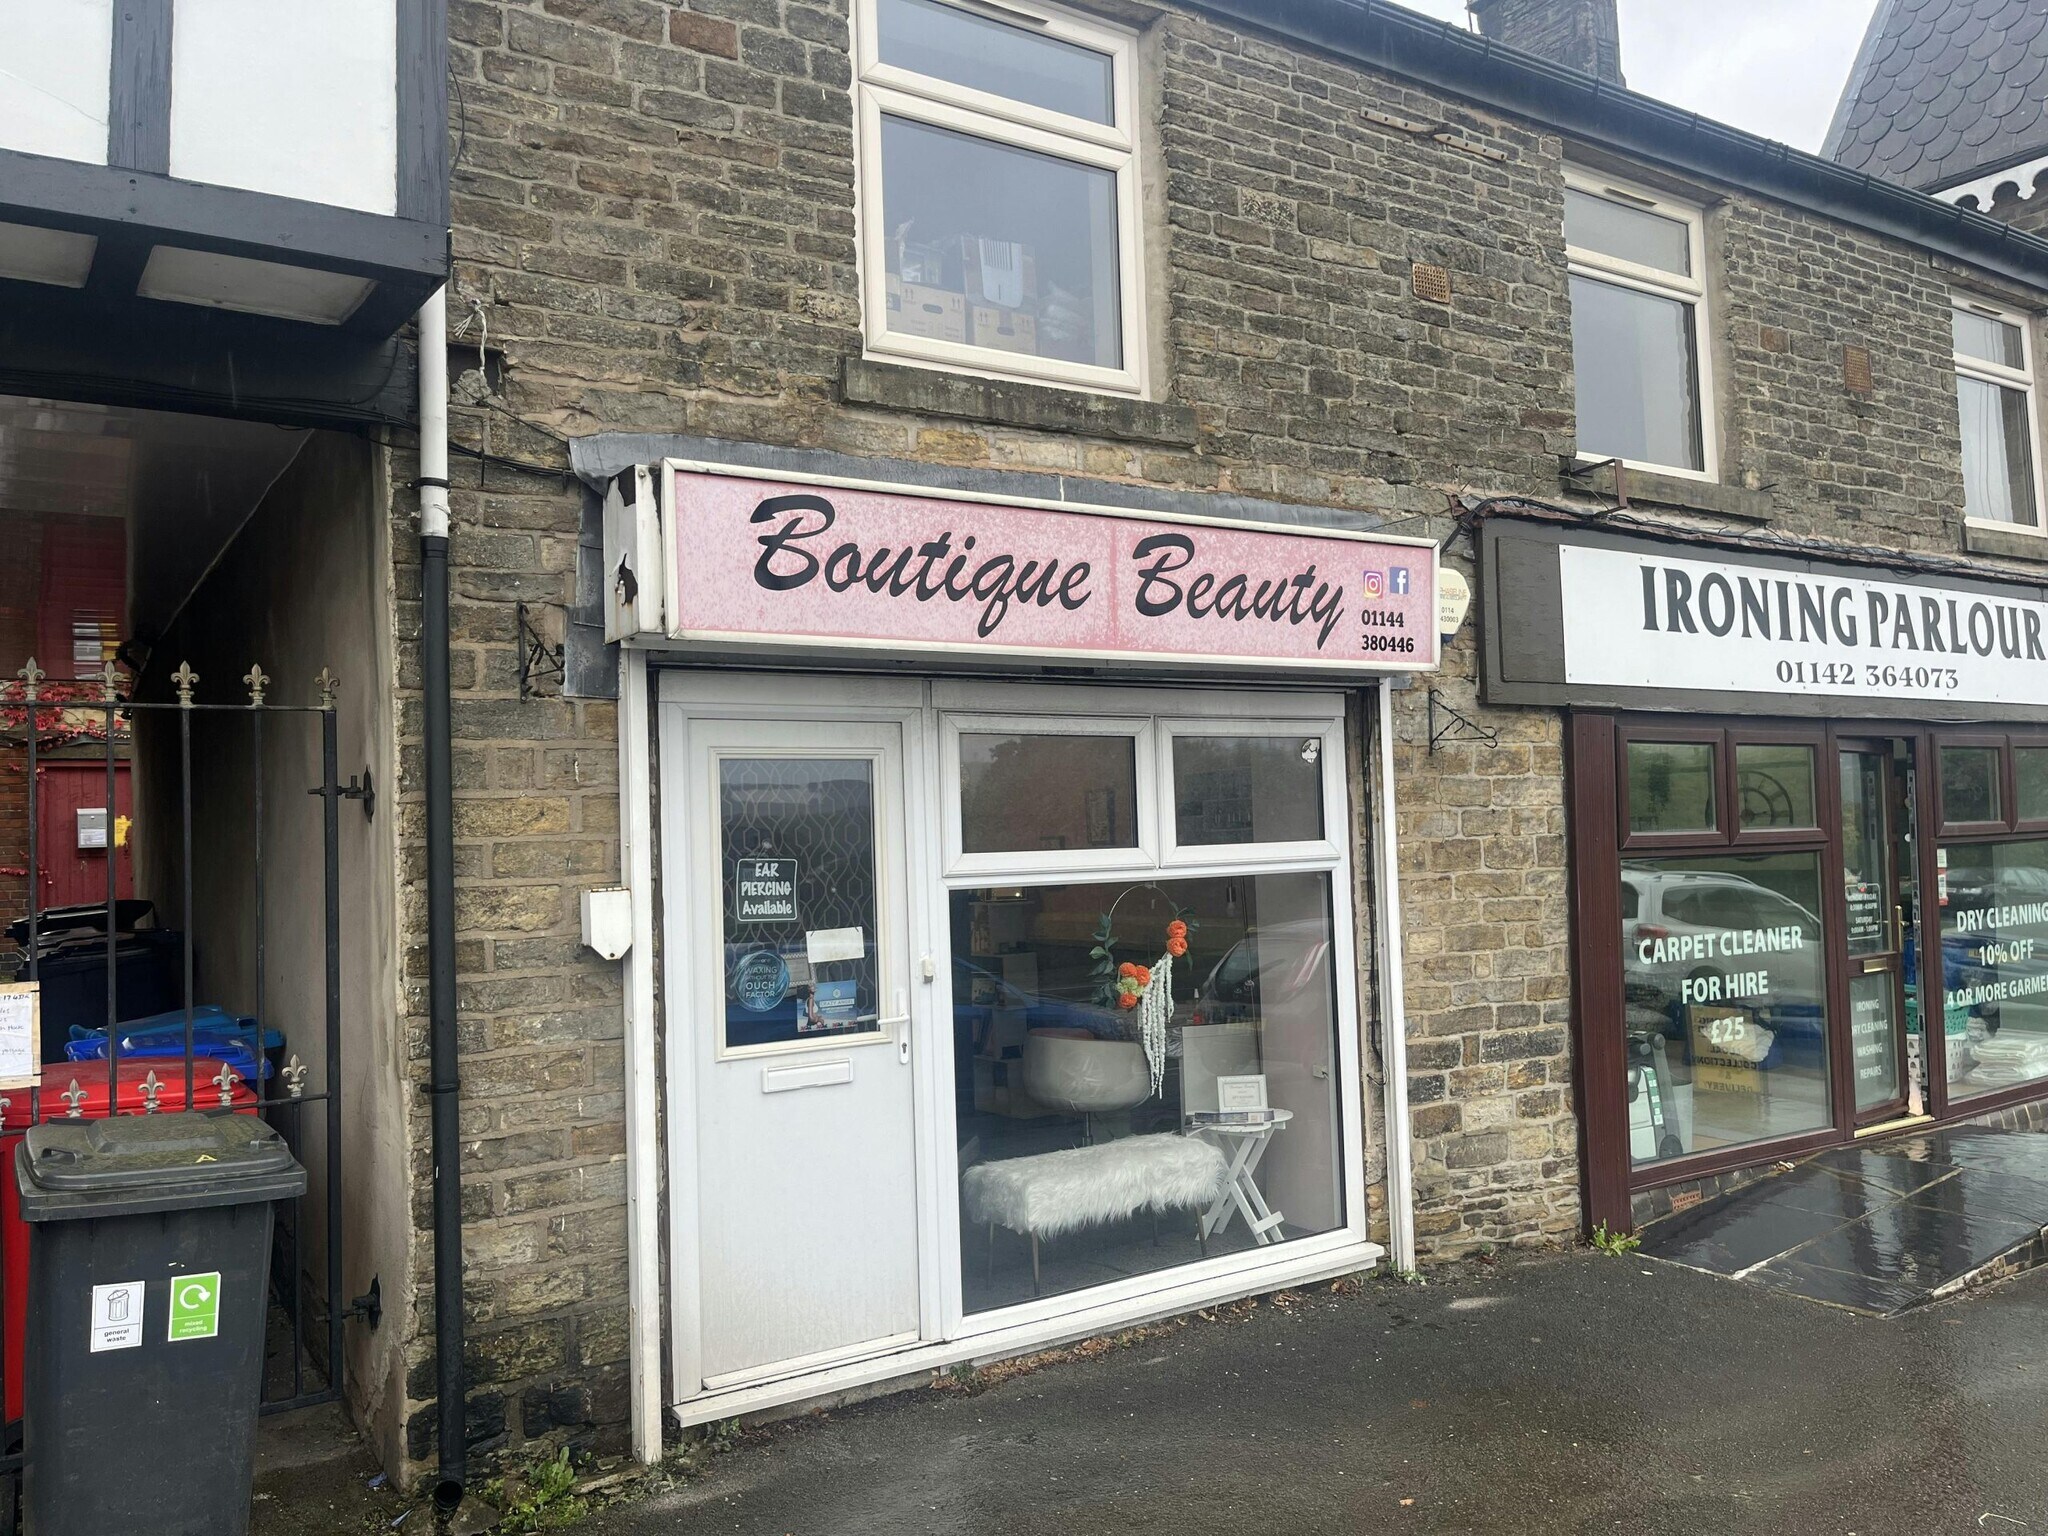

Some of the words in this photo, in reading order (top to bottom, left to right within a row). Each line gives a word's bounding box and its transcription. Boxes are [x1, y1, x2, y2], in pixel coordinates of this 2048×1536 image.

[750, 494, 1092, 639] Boutique
[1132, 533, 1345, 651] Beauty
[1361, 609, 1404, 628] 01144
[1639, 565, 1858, 648] IRONING
[1865, 590, 2047, 662] PARLOUR
[1361, 635, 1415, 653] 380446
[1775, 660, 1856, 686] 01142
[1865, 664, 1959, 690] 364073
[755, 862, 780, 877] EAR
[741, 881, 792, 896] PIERCING
[742, 900, 793, 915] Available
[1956, 908, 1985, 933] DRY
[1986, 902, 2048, 928] CLEANING
[1638, 933, 1716, 965] CARPET
[1719, 925, 1804, 957] CLEANER
[1978, 943, 2008, 966] 10%
[2009, 939, 2034, 961] OFF
[744, 966, 778, 974] WAXING
[745, 981, 776, 990] OUCH
[1681, 976, 1722, 1005] FOR
[1725, 970, 1769, 999] HIRE
[1946, 992, 1954, 1008] 4
[1956, 987, 1973, 1007] OR
[1974, 982, 2008, 1004] MORE
[2009, 974, 2048, 998] GARME
[745, 990, 776, 998] FACTOR
[1856, 999, 1880, 1012] IRONING
[1711, 1016, 1745, 1044] £25
[1861, 1019, 1888, 1034] CLEANING
[1857, 1042, 1883, 1057] WASHING
[1860, 1065, 1882, 1079] REPAIRS
[179, 1325, 208, 1334] recycling
[184, 1319, 204, 1327] mixed
[104, 1328, 130, 1337] general
[106, 1335, 126, 1343] waste
